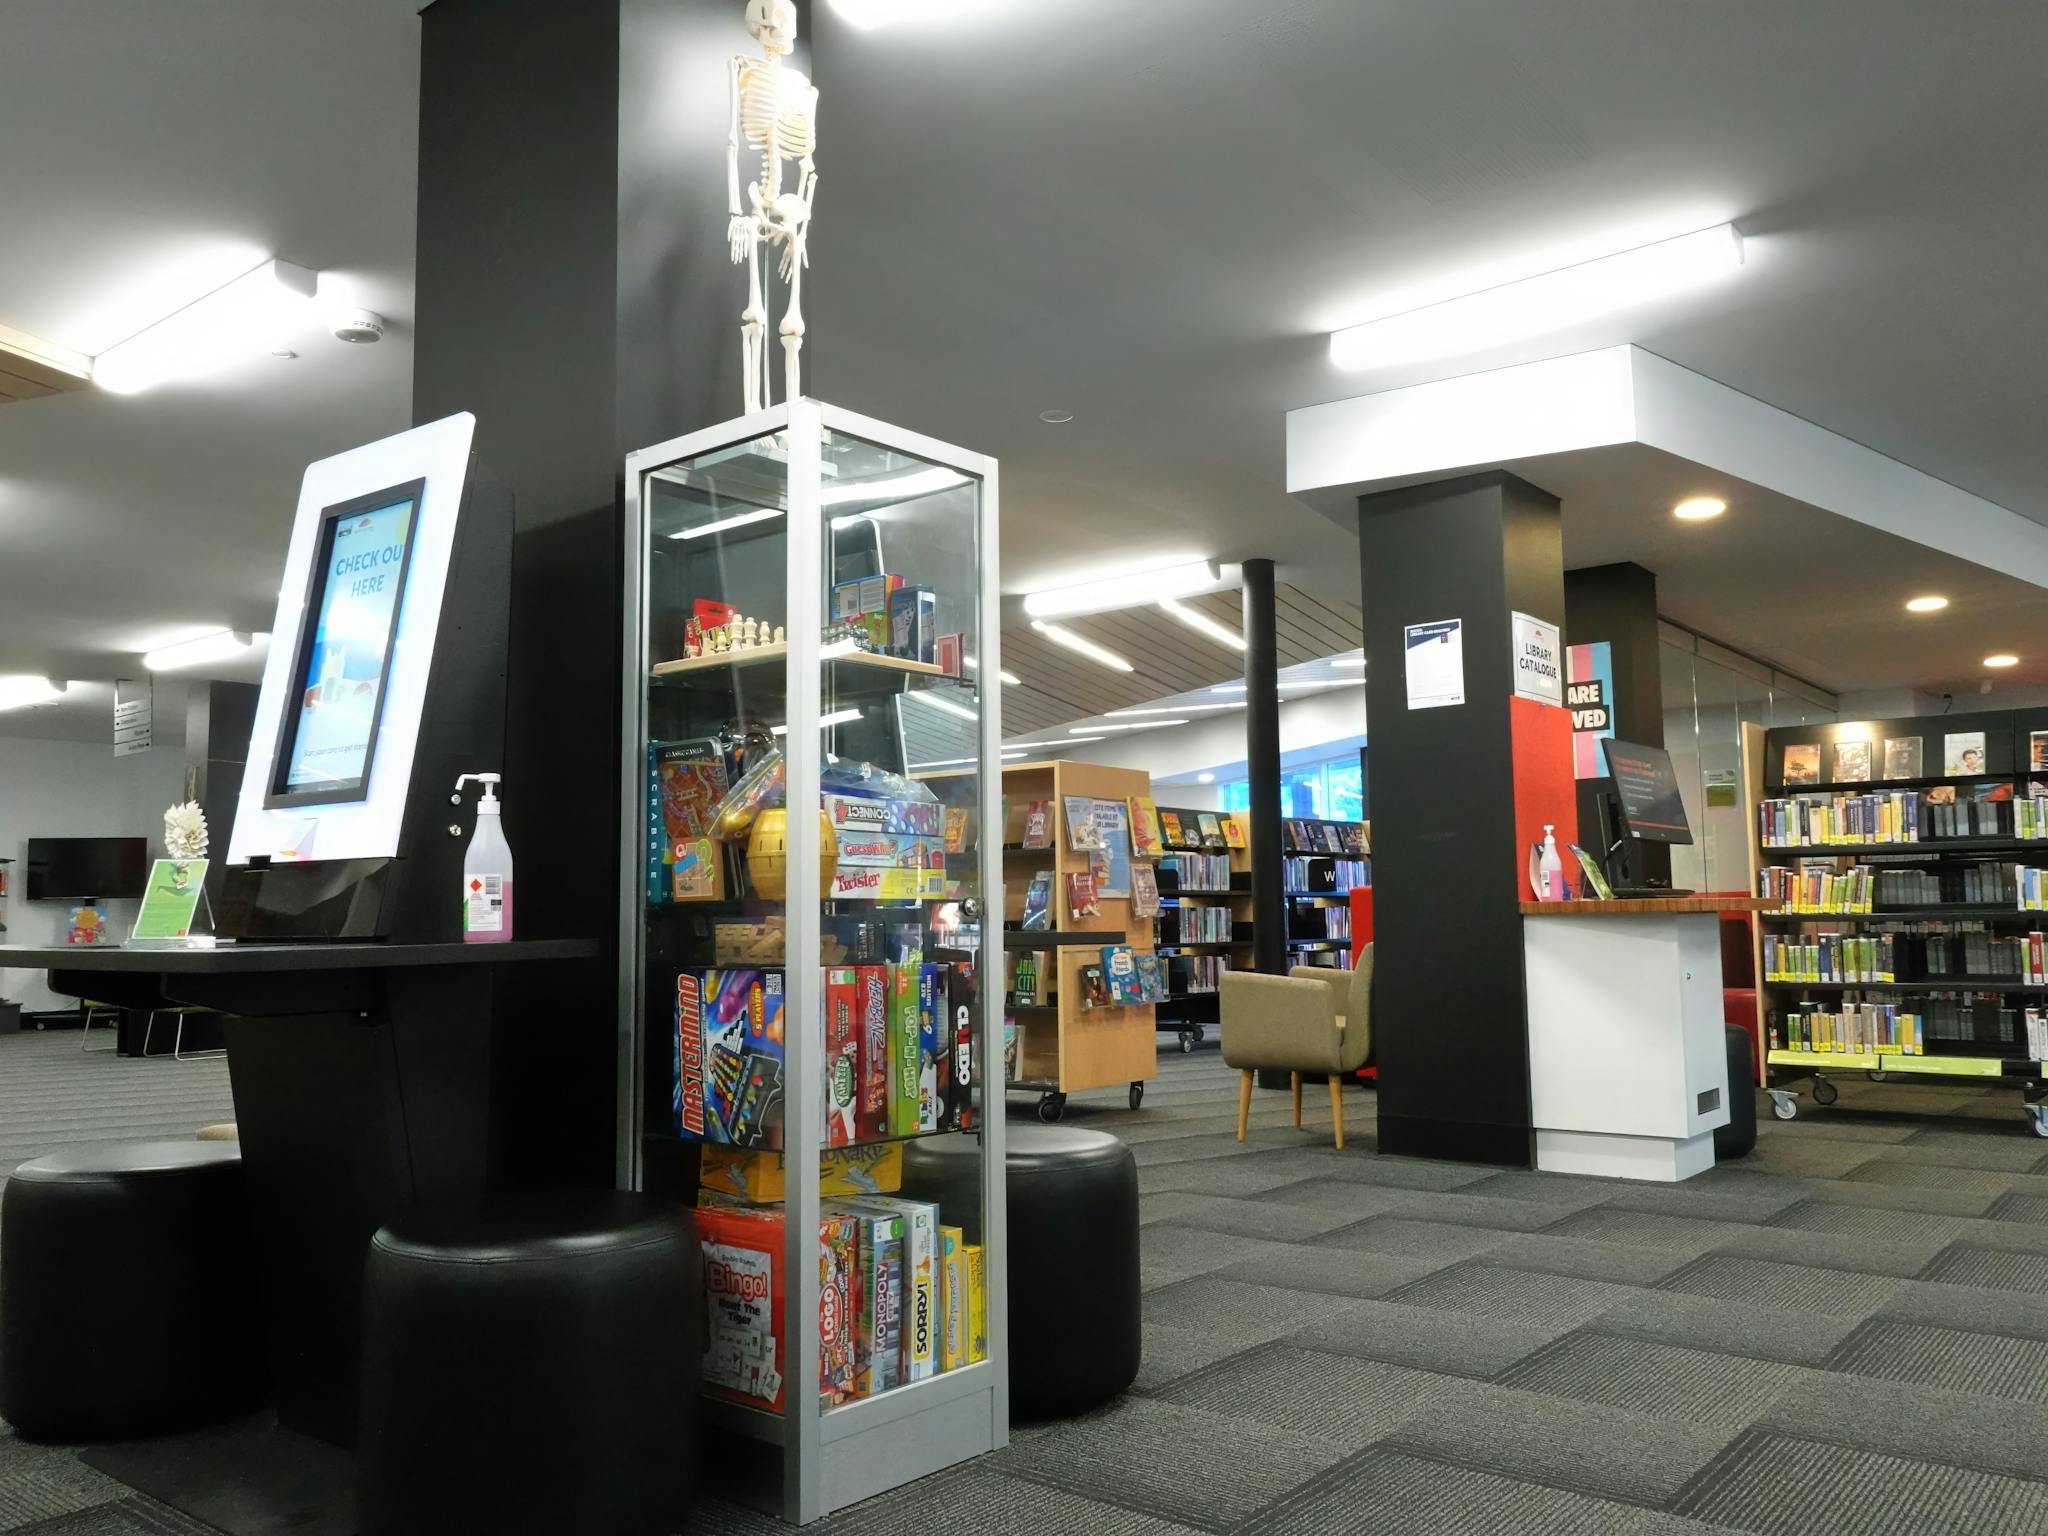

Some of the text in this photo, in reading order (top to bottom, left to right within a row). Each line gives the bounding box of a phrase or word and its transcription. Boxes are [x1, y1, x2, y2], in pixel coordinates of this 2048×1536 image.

[336, 549, 380, 577] CHECK
[351, 574, 385, 599] HERE
[1519, 658, 1557, 679] CATALOGUE
[1525, 643, 1552, 662] LIBRARY
[1567, 684, 1600, 706] ARE
[650, 769, 658, 879] SCRABBLE
[847, 805, 891, 820] CONNECT
[836, 871, 881, 893] Twister
[1323, 870, 1336, 882] W
[867, 972, 886, 1055] HEDBANZ
[903, 1005, 918, 1099] POP-N-HOP
[957, 1004, 971, 1086] CLUEDO
[835, 1056, 850, 1106] YAHTZEE
[707, 1260, 768, 1303] Bingo!
[744, 1303, 760, 1316] The
[823, 1288, 834, 1342] LOGO
[876, 1263, 888, 1353] MONOPOLY
[916, 1283, 928, 1355] SORRY!
